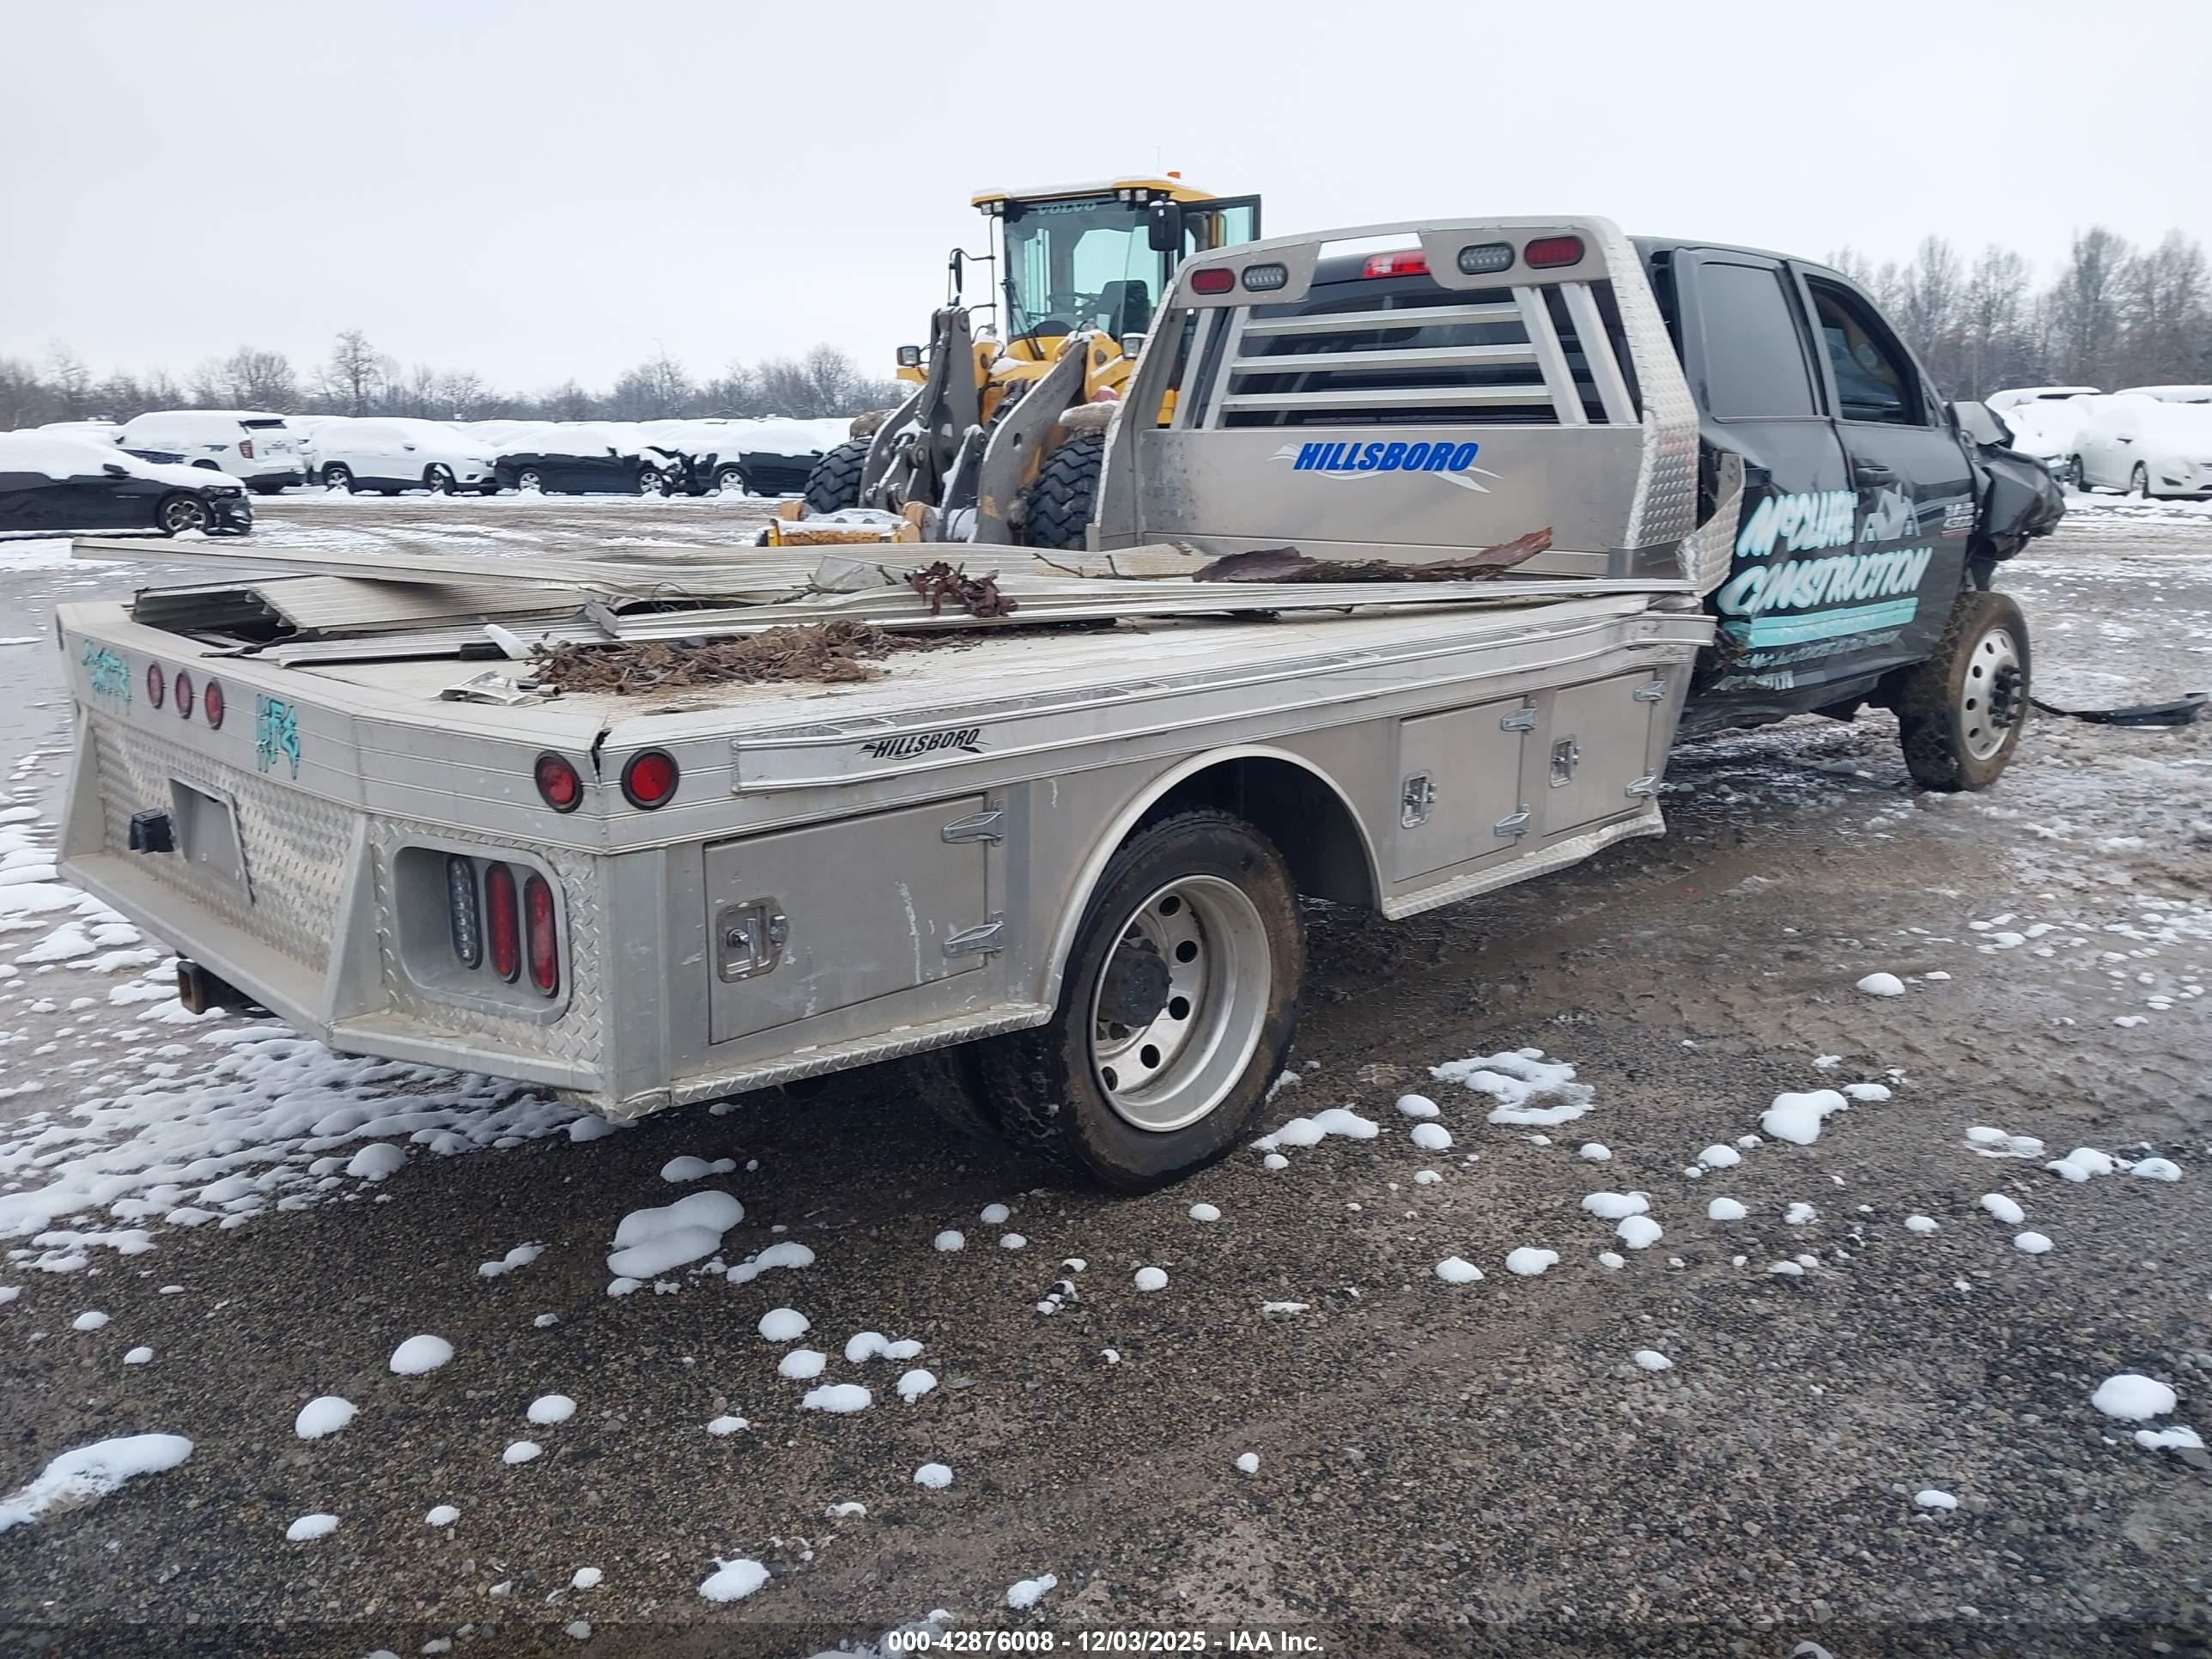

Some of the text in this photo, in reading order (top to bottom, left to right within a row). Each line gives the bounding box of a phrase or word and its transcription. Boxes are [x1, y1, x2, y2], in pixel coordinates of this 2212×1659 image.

[1037, 201, 1097, 216] VOLVO
[1292, 441, 1480, 471] HILLSBORO
[1717, 547, 1933, 617] CONSTRUCTION
[872, 728, 981, 759] HILLSBORO
